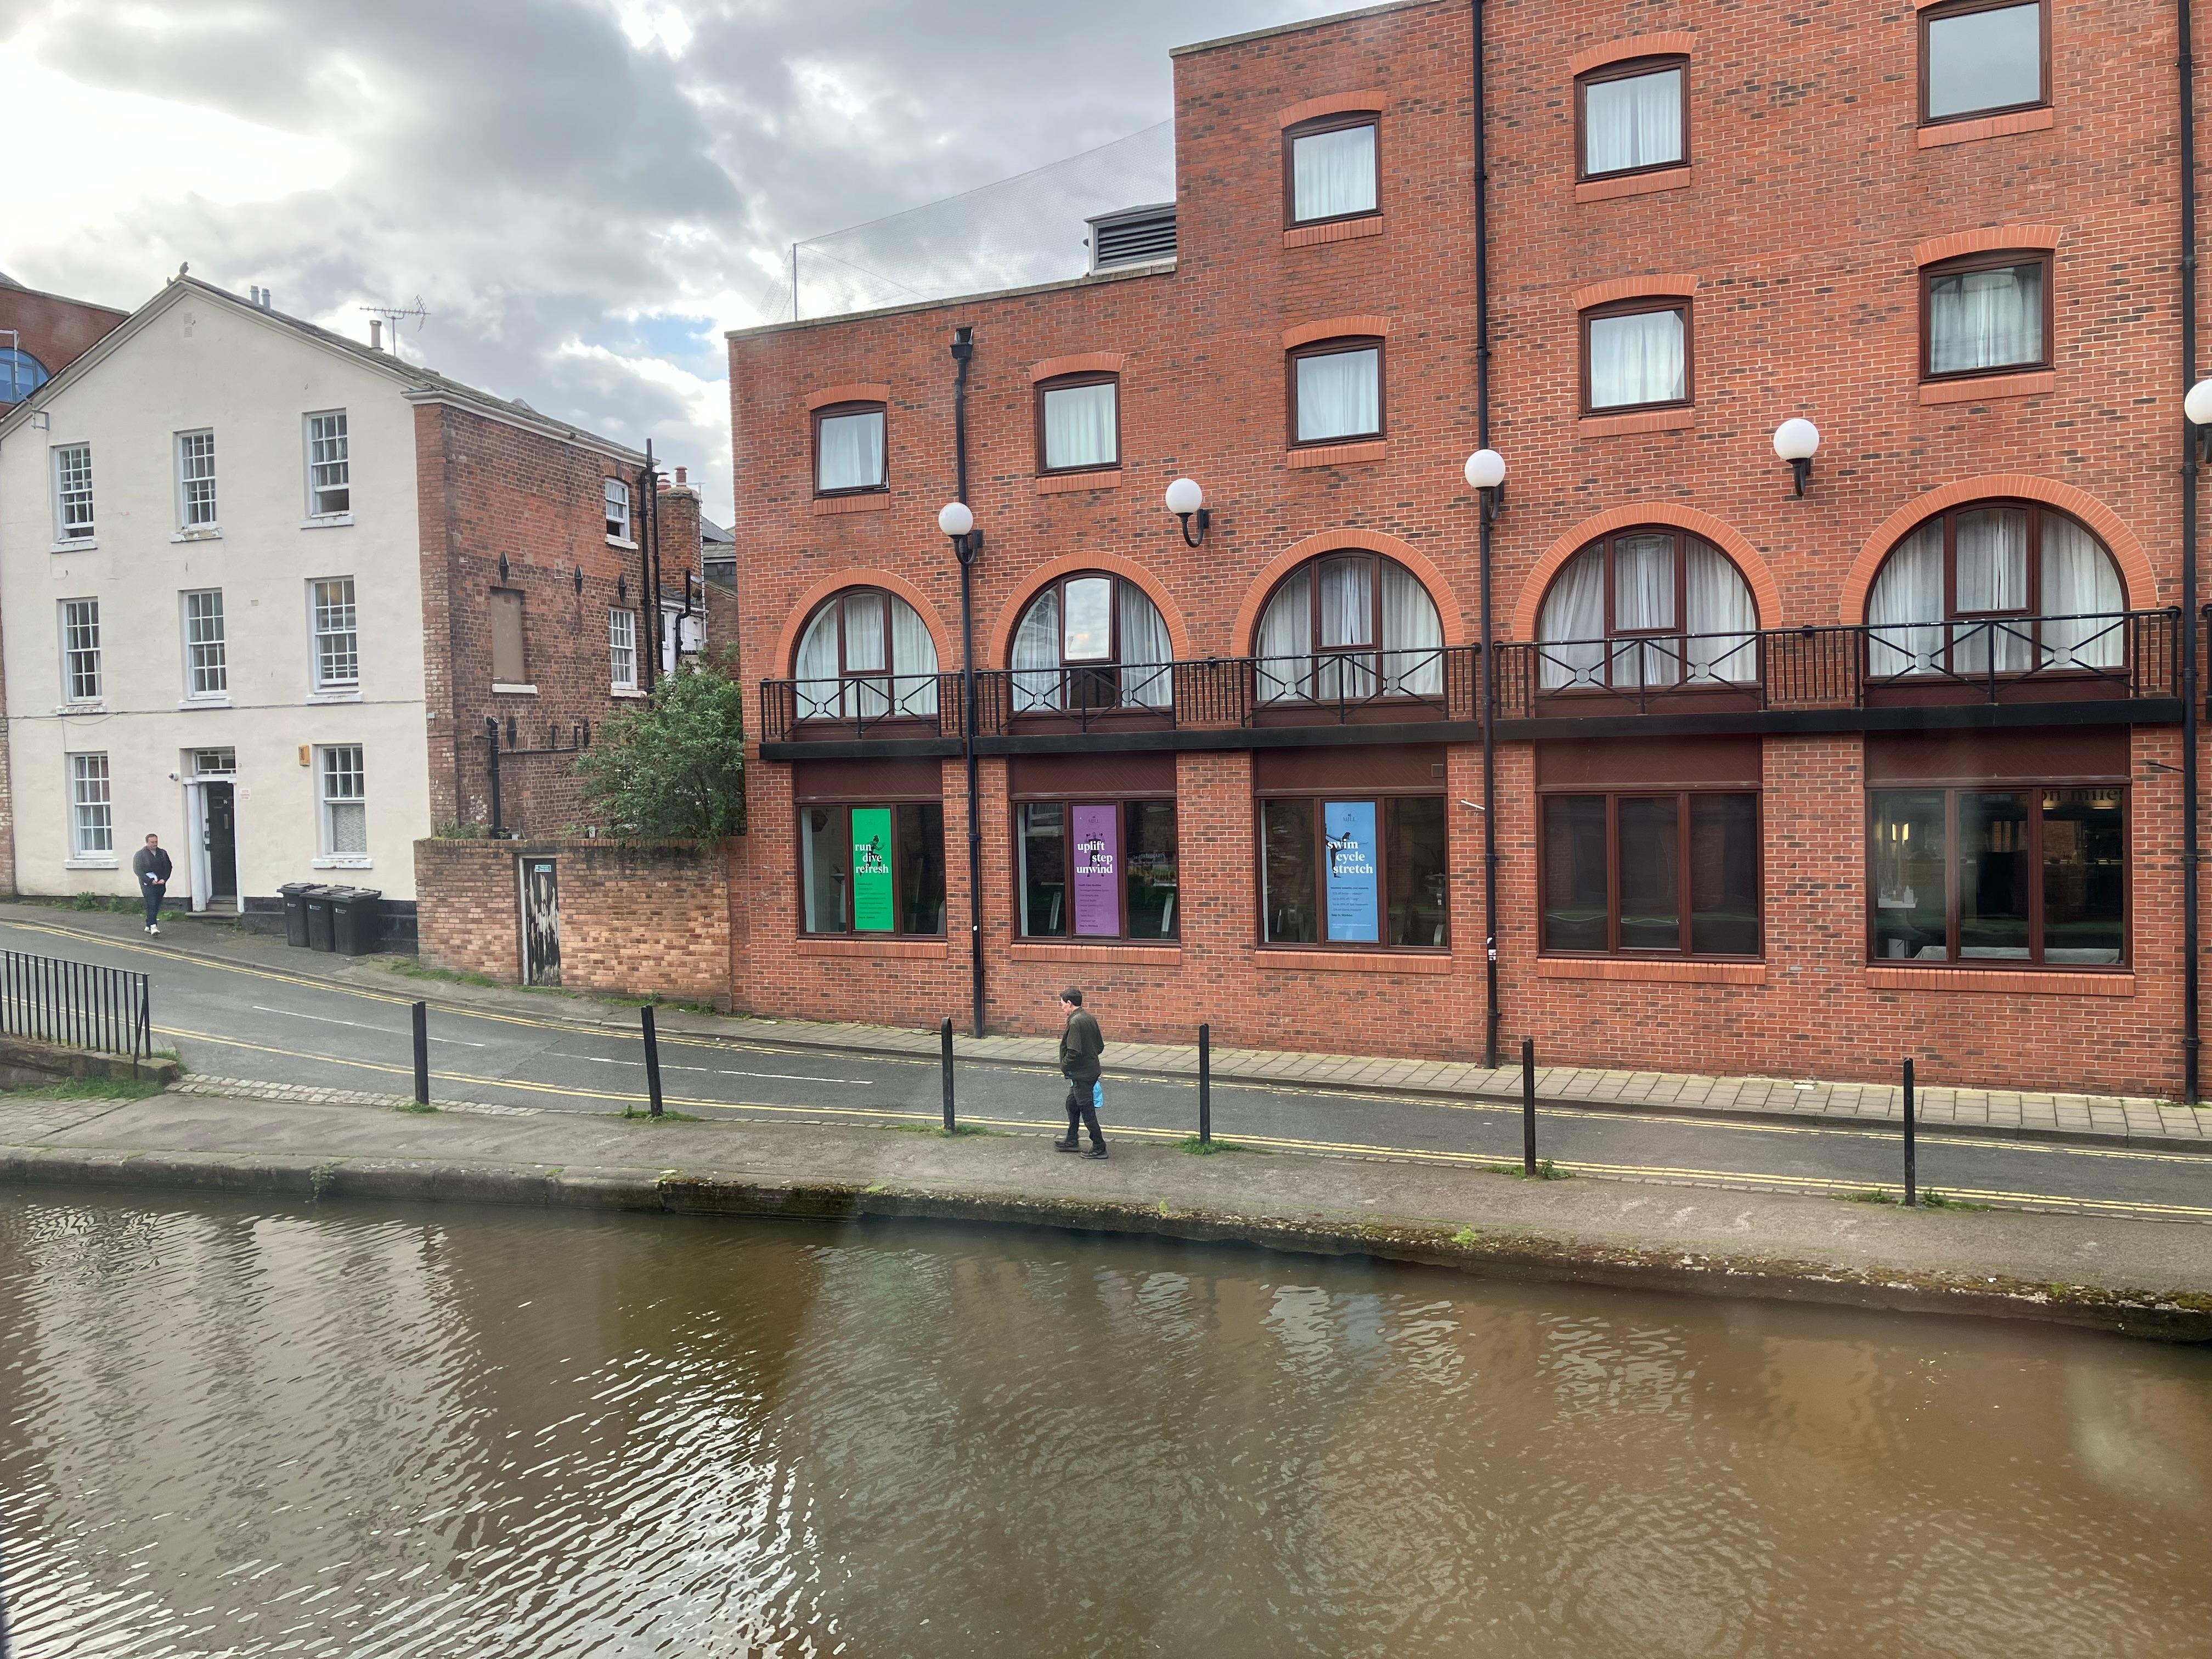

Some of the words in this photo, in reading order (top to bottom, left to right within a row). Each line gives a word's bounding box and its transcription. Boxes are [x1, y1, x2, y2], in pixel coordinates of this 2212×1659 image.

[1077, 841, 1105, 853] uplift
[1327, 838, 1358, 849] swim
[862, 853, 882, 862] dive
[1092, 853, 1113, 865] step
[1335, 851, 1365, 864] cycle
[856, 864, 889, 873] refresh
[1076, 864, 1113, 873] unwind
[1333, 864, 1373, 874] stretch
